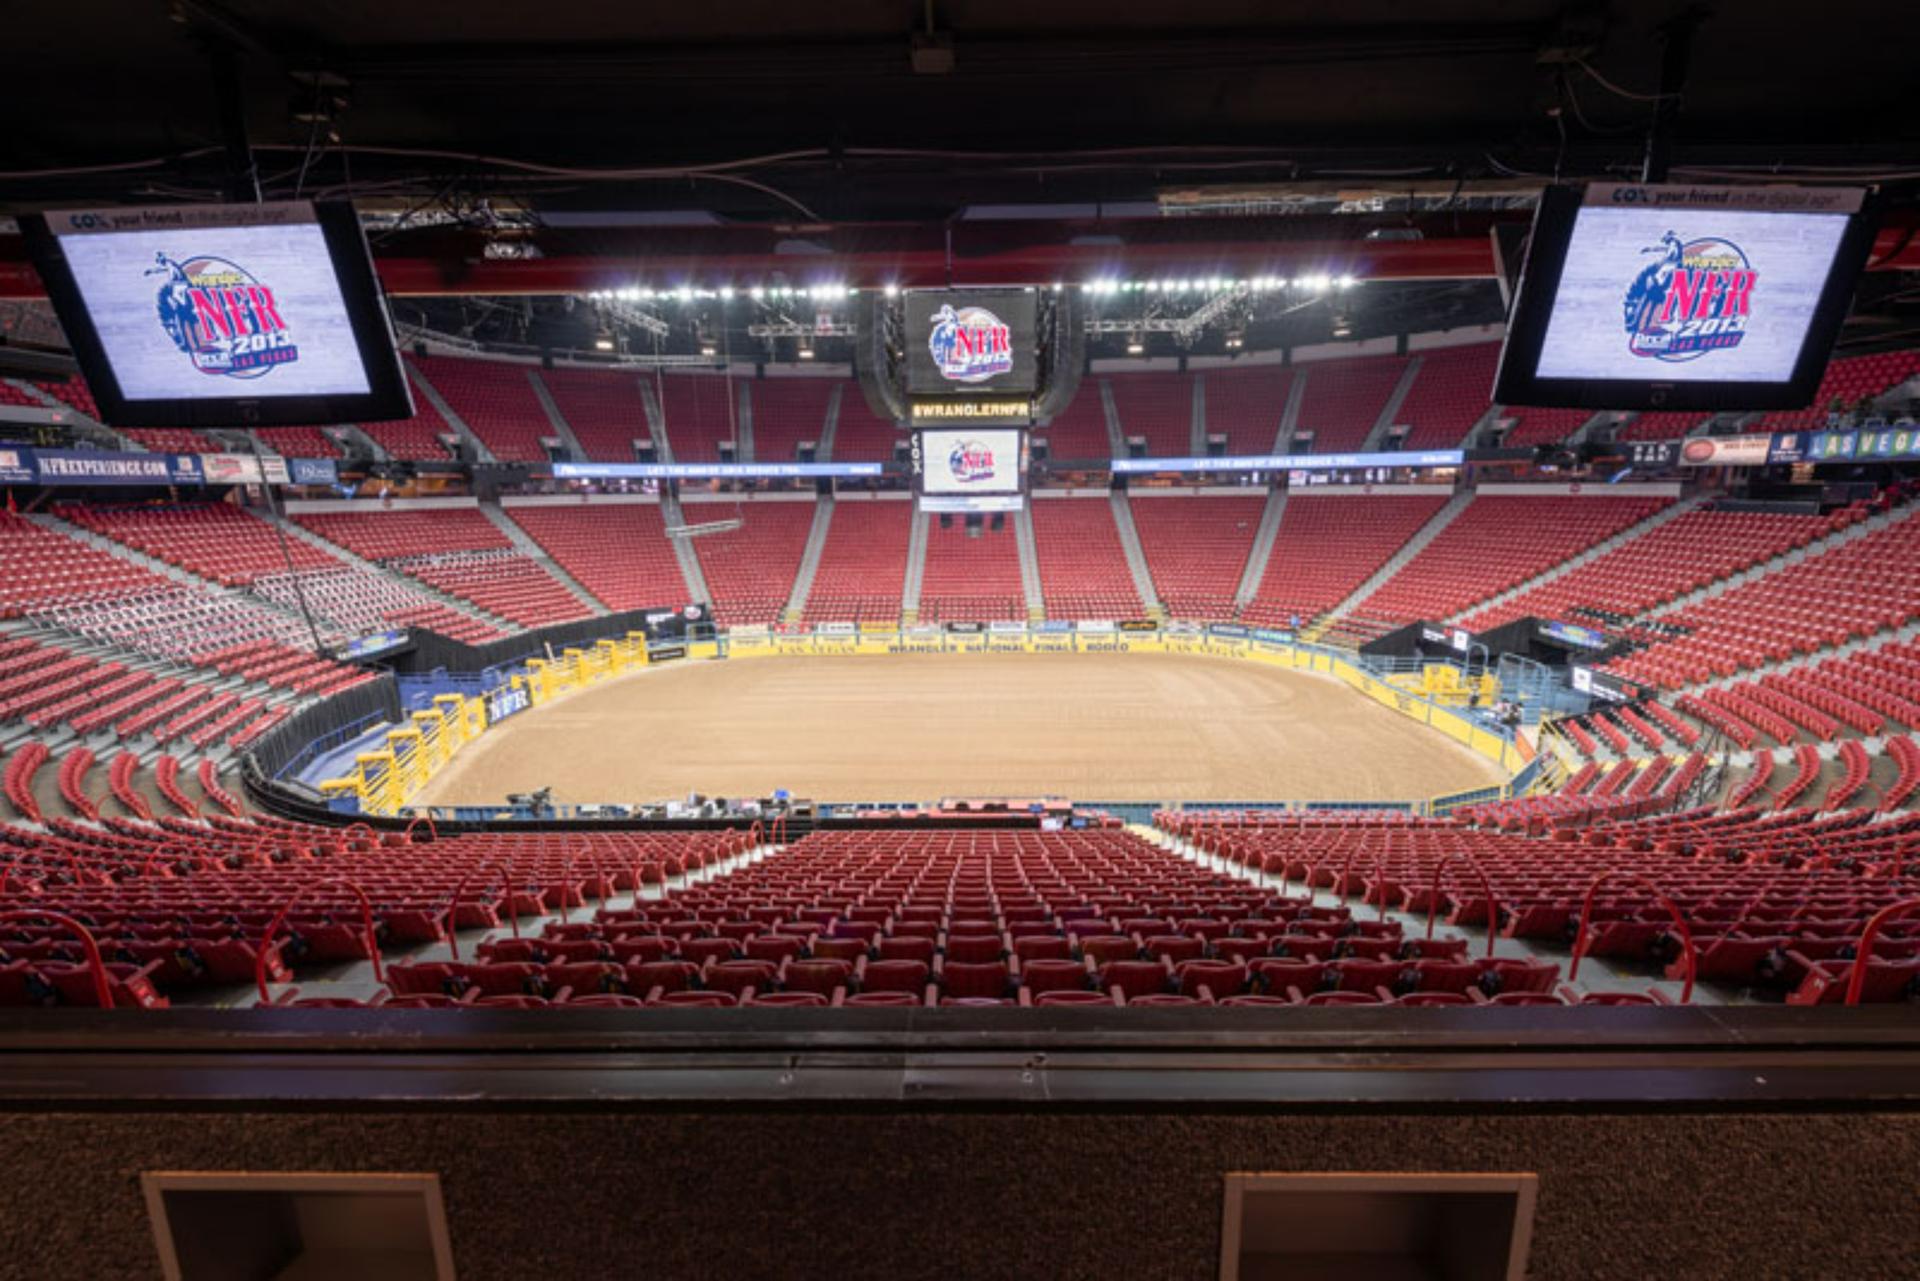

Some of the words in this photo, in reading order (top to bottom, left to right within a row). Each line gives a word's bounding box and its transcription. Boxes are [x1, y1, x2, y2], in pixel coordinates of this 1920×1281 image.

[1656, 192, 1687, 205] your
[1689, 188, 1729, 203] friend
[113, 213, 141, 228] your
[143, 210, 183, 225] friend
[1660, 269, 1758, 321] NFR
[190, 286, 287, 341] NFR
[232, 331, 290, 354] 2013
[956, 326, 1009, 357] NFR
[911, 433, 922, 475] COX
[1812, 434, 1854, 455] LAS
